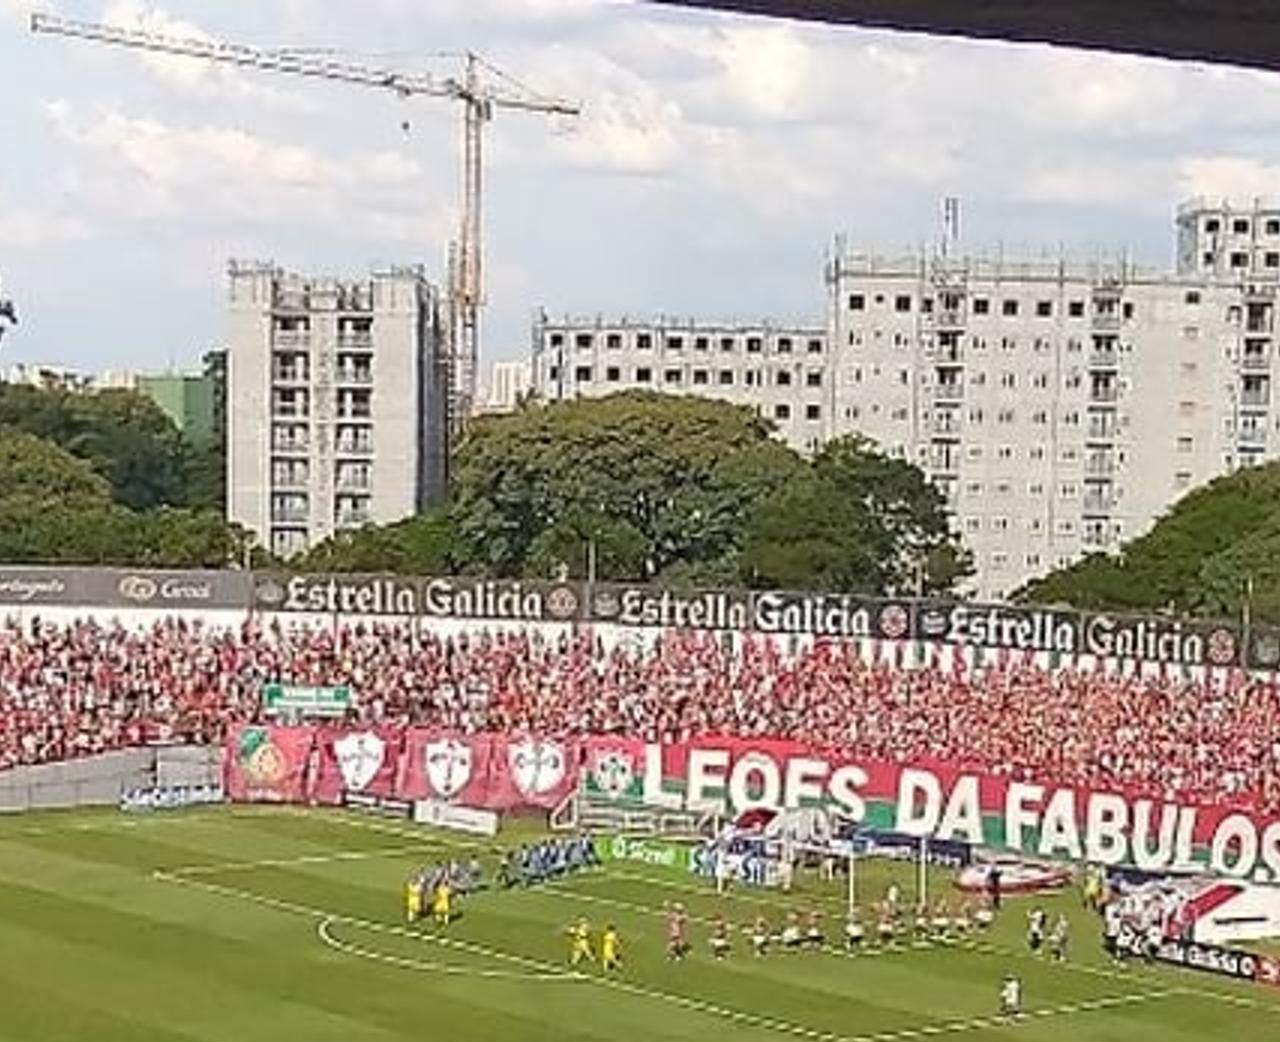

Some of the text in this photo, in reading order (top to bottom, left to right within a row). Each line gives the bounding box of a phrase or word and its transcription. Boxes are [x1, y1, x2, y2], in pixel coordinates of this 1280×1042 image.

[283, 577, 543, 618] Estrella Galicia
[619, 589, 871, 635] Estrella Galicia
[945, 606, 1203, 663] Estrella Galicia
[894, 767, 984, 846] DA
